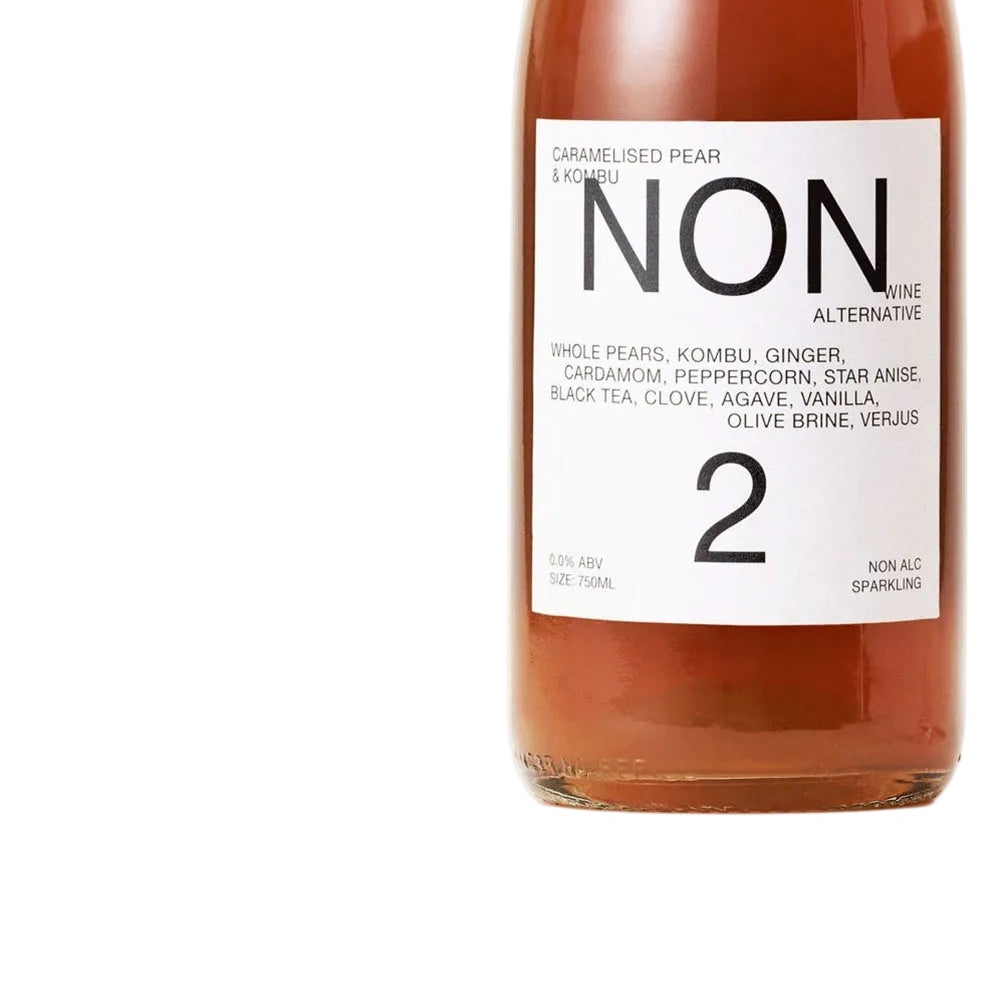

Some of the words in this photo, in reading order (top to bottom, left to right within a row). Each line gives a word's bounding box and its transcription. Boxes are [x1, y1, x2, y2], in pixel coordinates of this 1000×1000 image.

[552, 146, 663, 163] CARAMELISED
[670, 148, 721, 164] PEAR
[552, 168, 560, 183] &
[564, 168, 619, 184] KOMBU
[582, 176, 889, 296] NON
[885, 283, 922, 299] WINE
[812, 304, 922, 323] ALTERNATIVE
[552, 343, 600, 360] WHOLE
[606, 345, 670, 362] PEARS,
[678, 347, 758, 365] KOMBU,
[765, 347, 846, 366] GINGER,
[564, 364, 667, 384] CARDAMOM,
[675, 369, 817, 387] PEPPERCORN,
[824, 368, 869, 385] STAR
[873, 365, 922, 384] ANISE,
[551, 385, 596, 402] BLACK
[603, 388, 637, 405] TEA,
[644, 389, 714, 407] CLOVE,
[721, 391, 793, 409] AGAVE,
[800, 389, 880, 408] VANILLA,
[727, 412, 785, 429] OLIVE
[792, 412, 854, 431] BRINE,
[859, 409, 919, 428] VERJUS
[693, 451, 767, 564] 2
[549, 553, 575, 568] 0.0%
[578, 556, 603, 569] ABV
[868, 559, 897, 574] NON
[899, 557, 922, 572] ALC
[549, 572, 575, 586] SIZE:
[578, 575, 616, 590] 750ML
[851, 576, 922, 594] SPARKLING
